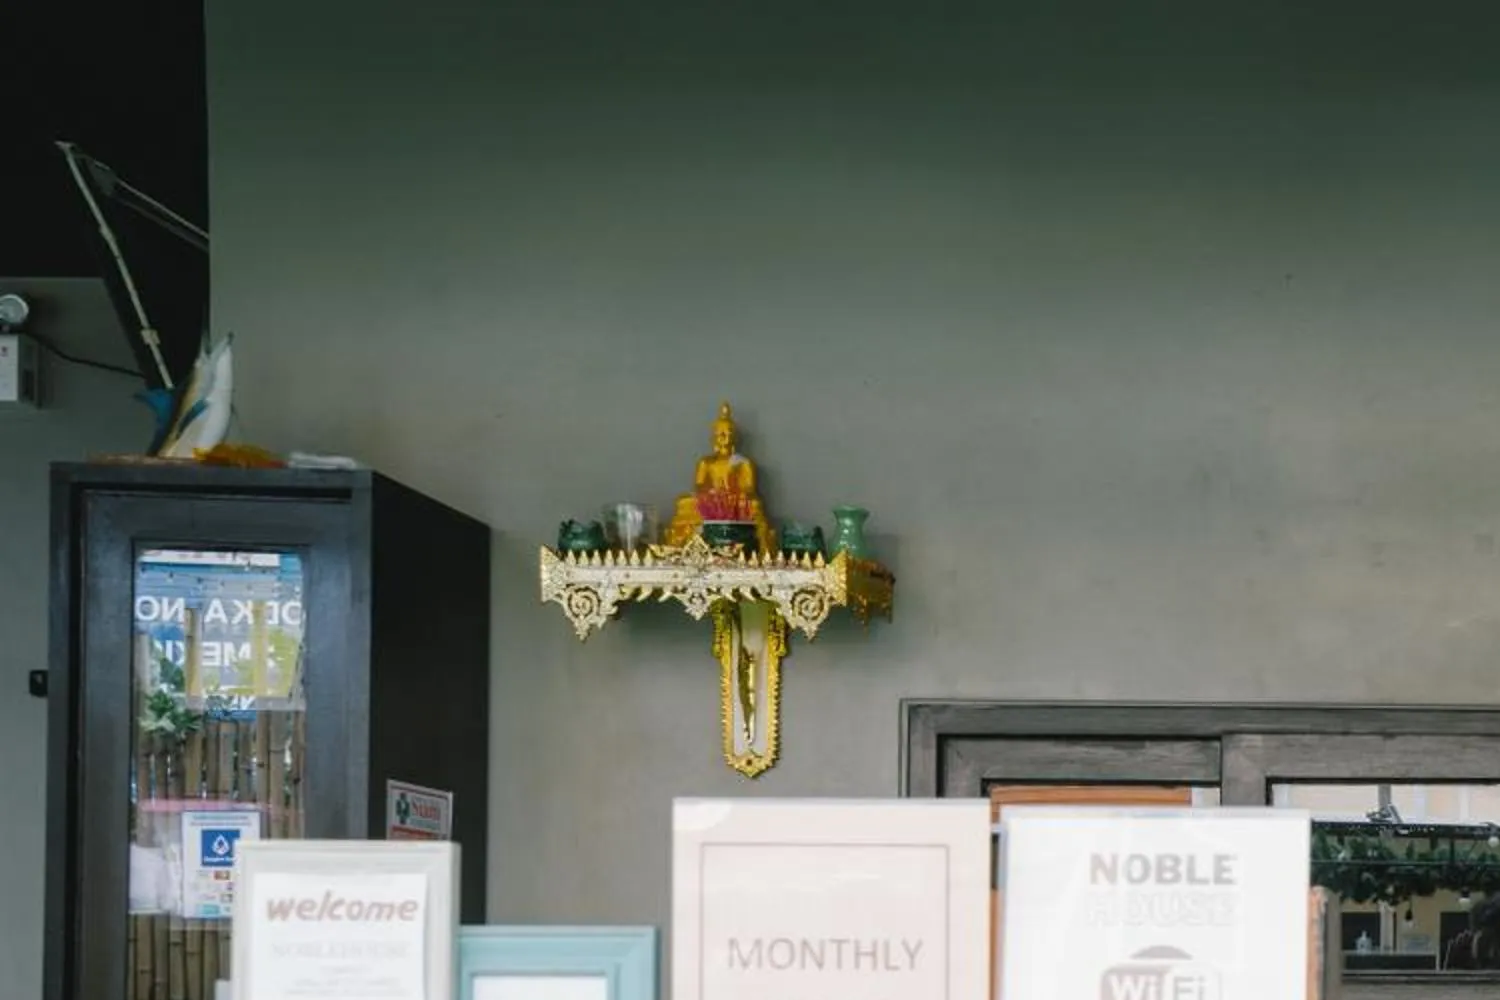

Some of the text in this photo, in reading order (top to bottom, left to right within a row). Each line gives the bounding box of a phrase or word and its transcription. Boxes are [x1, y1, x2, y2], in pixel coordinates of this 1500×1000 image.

[1089, 853, 1238, 886] NOBLE
[266, 888, 418, 922] welcome
[1086, 889, 1240, 927] HOUSE
[728, 937, 923, 971] MONTHLY
